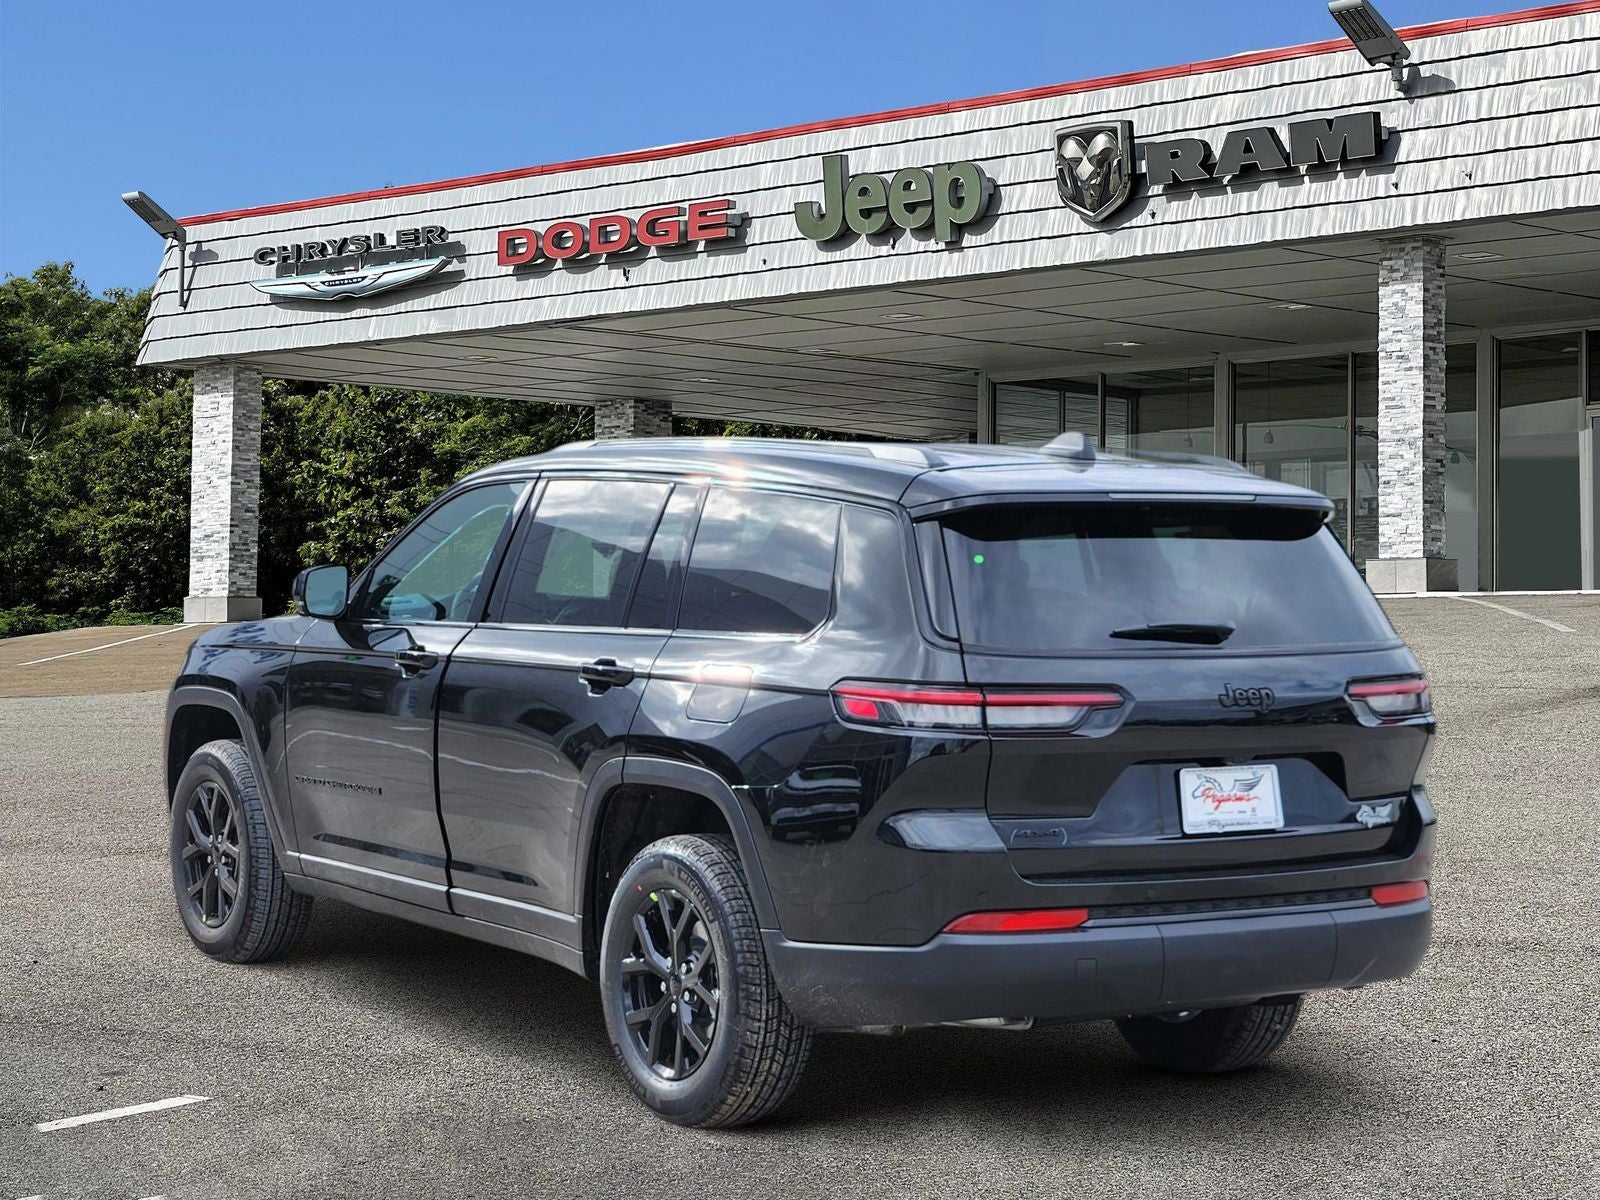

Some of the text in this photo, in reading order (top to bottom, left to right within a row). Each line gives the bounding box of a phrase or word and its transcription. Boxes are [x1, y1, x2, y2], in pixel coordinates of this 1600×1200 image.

[1145, 112, 1378, 186] RAM
[794, 155, 984, 242] Jeep
[253, 225, 449, 266] CHRYSLER
[497, 199, 735, 266] DODGE
[1218, 683, 1275, 713] Jeep
